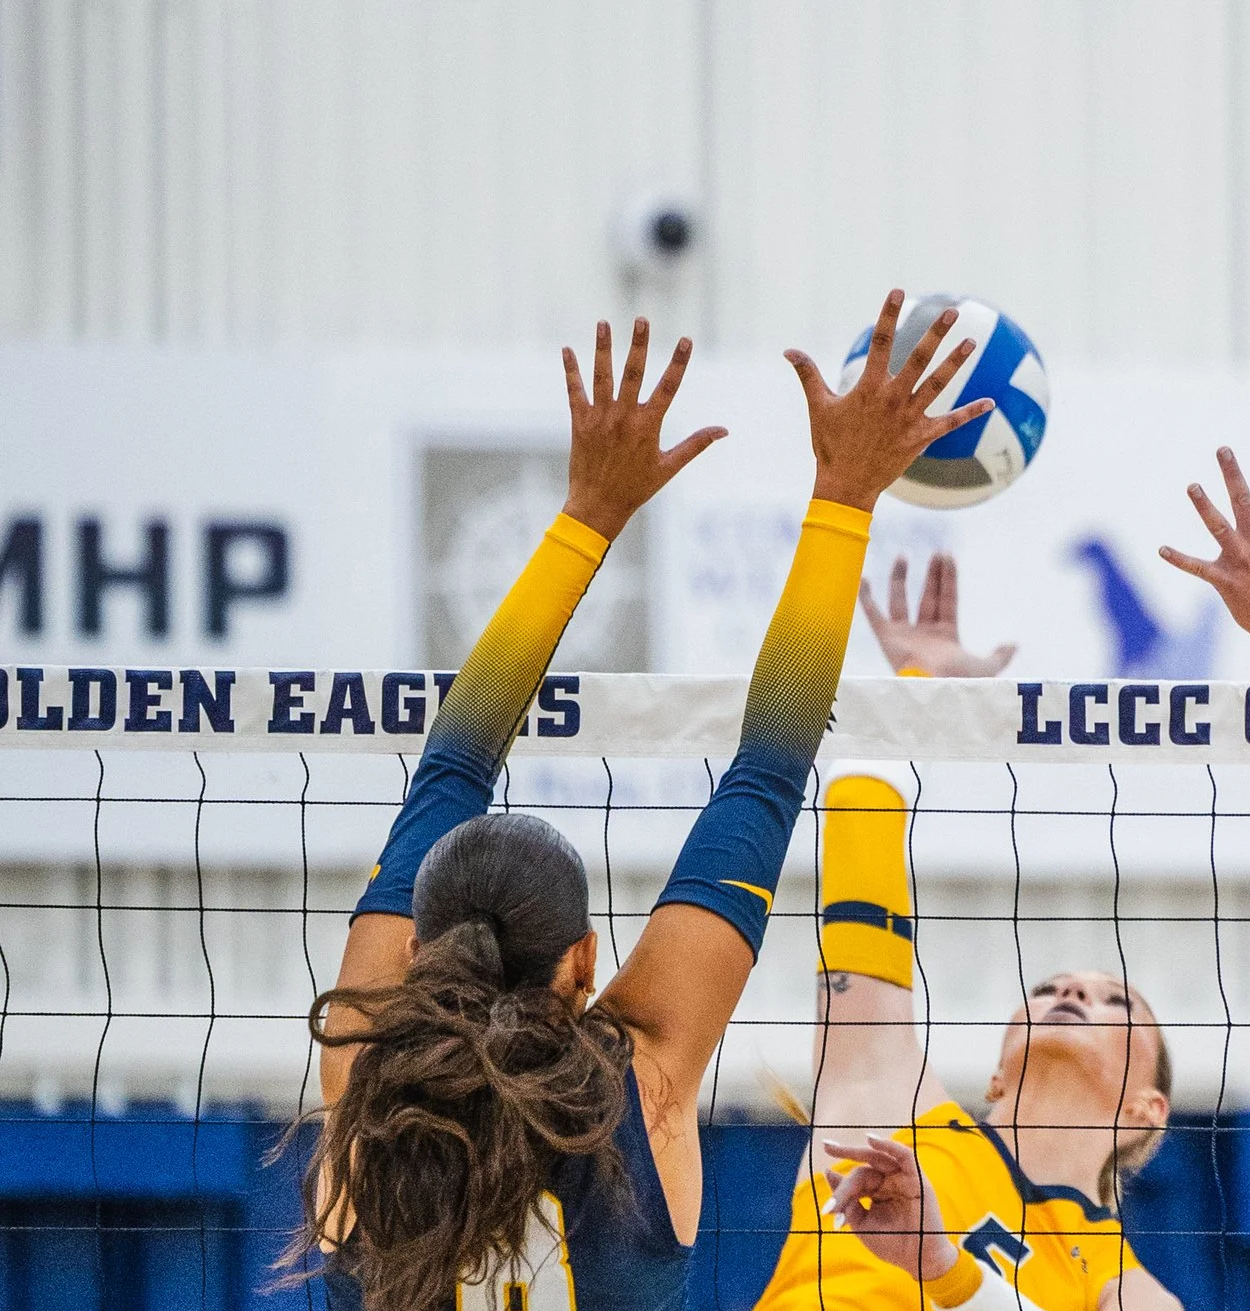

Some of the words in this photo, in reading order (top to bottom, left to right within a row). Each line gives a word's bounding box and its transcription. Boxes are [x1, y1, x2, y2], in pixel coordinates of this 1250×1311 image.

[0, 668, 235, 732] LDEN
[267, 671, 581, 737] EAGS
[1017, 682, 1211, 746] LCCC
